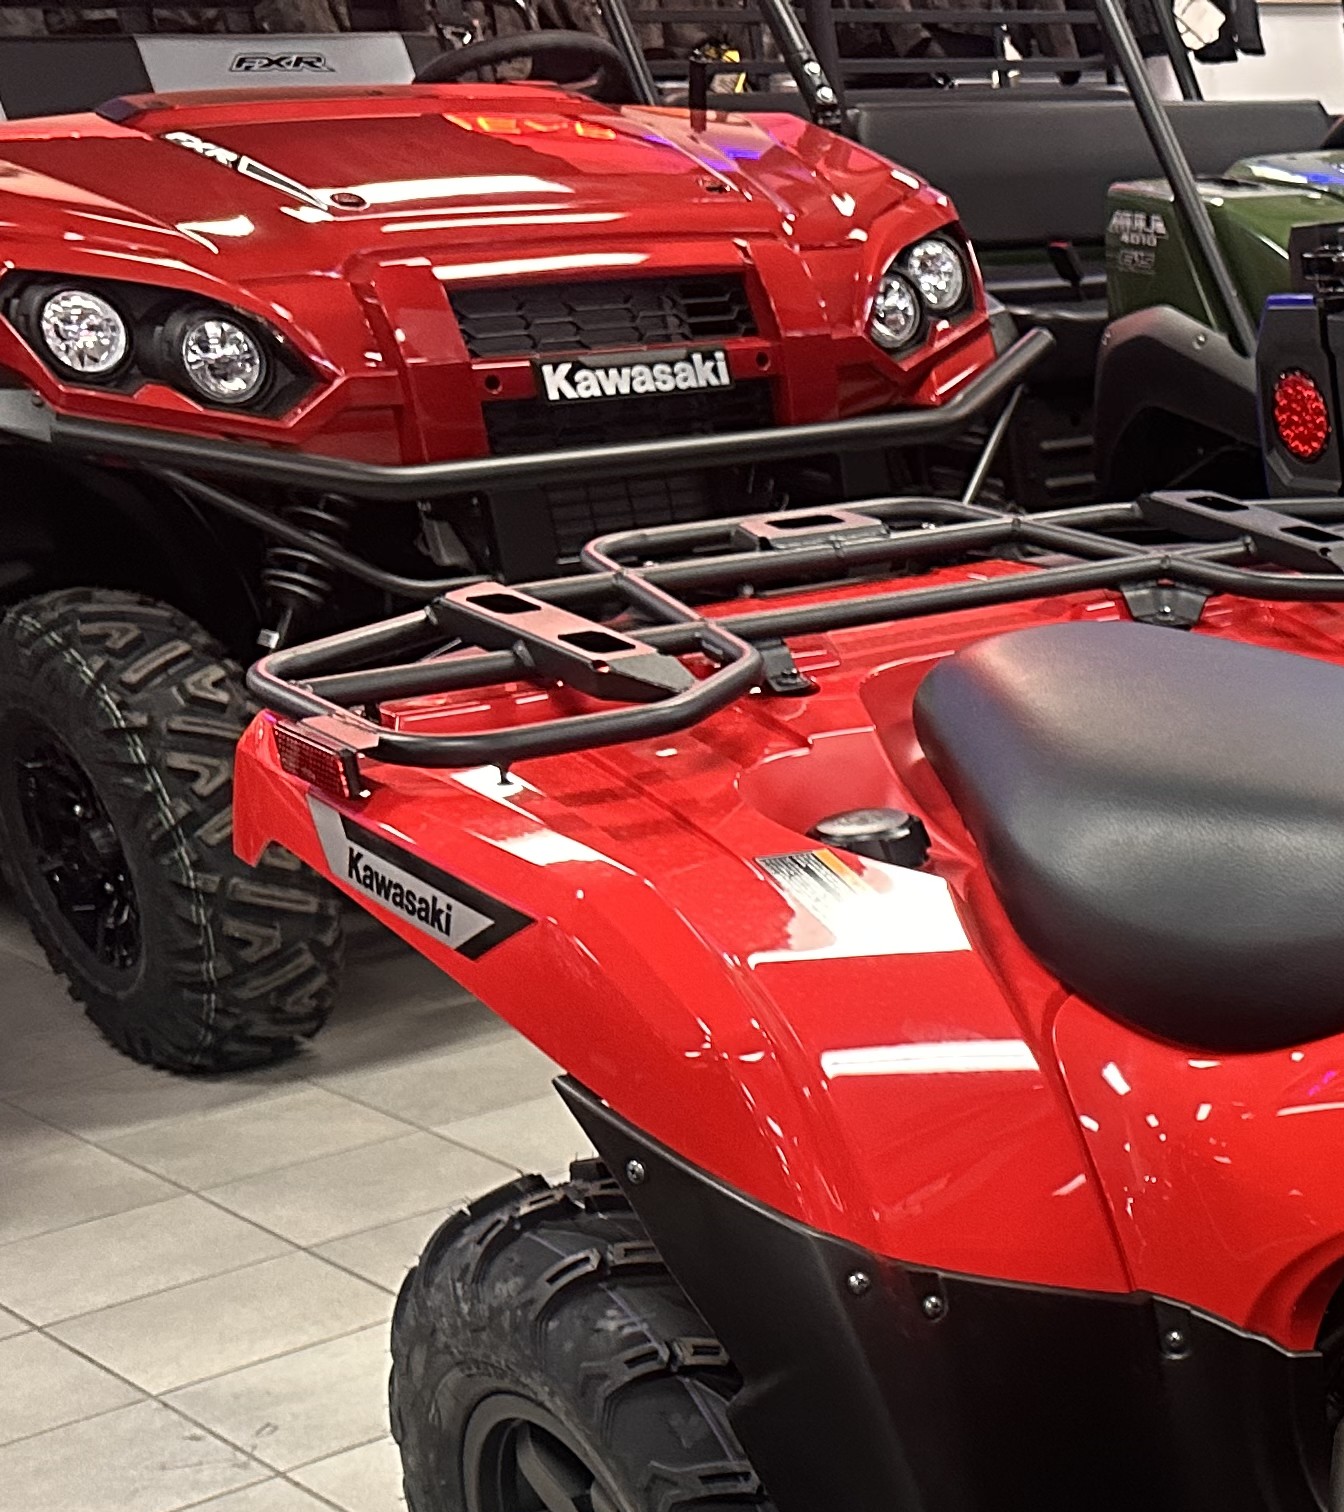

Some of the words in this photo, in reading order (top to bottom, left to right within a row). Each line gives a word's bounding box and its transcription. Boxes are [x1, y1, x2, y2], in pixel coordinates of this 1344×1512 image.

[229, 52, 336, 73] FXR
[541, 351, 730, 401] Kawasaki
[348, 846, 453, 937] Kawasaki
